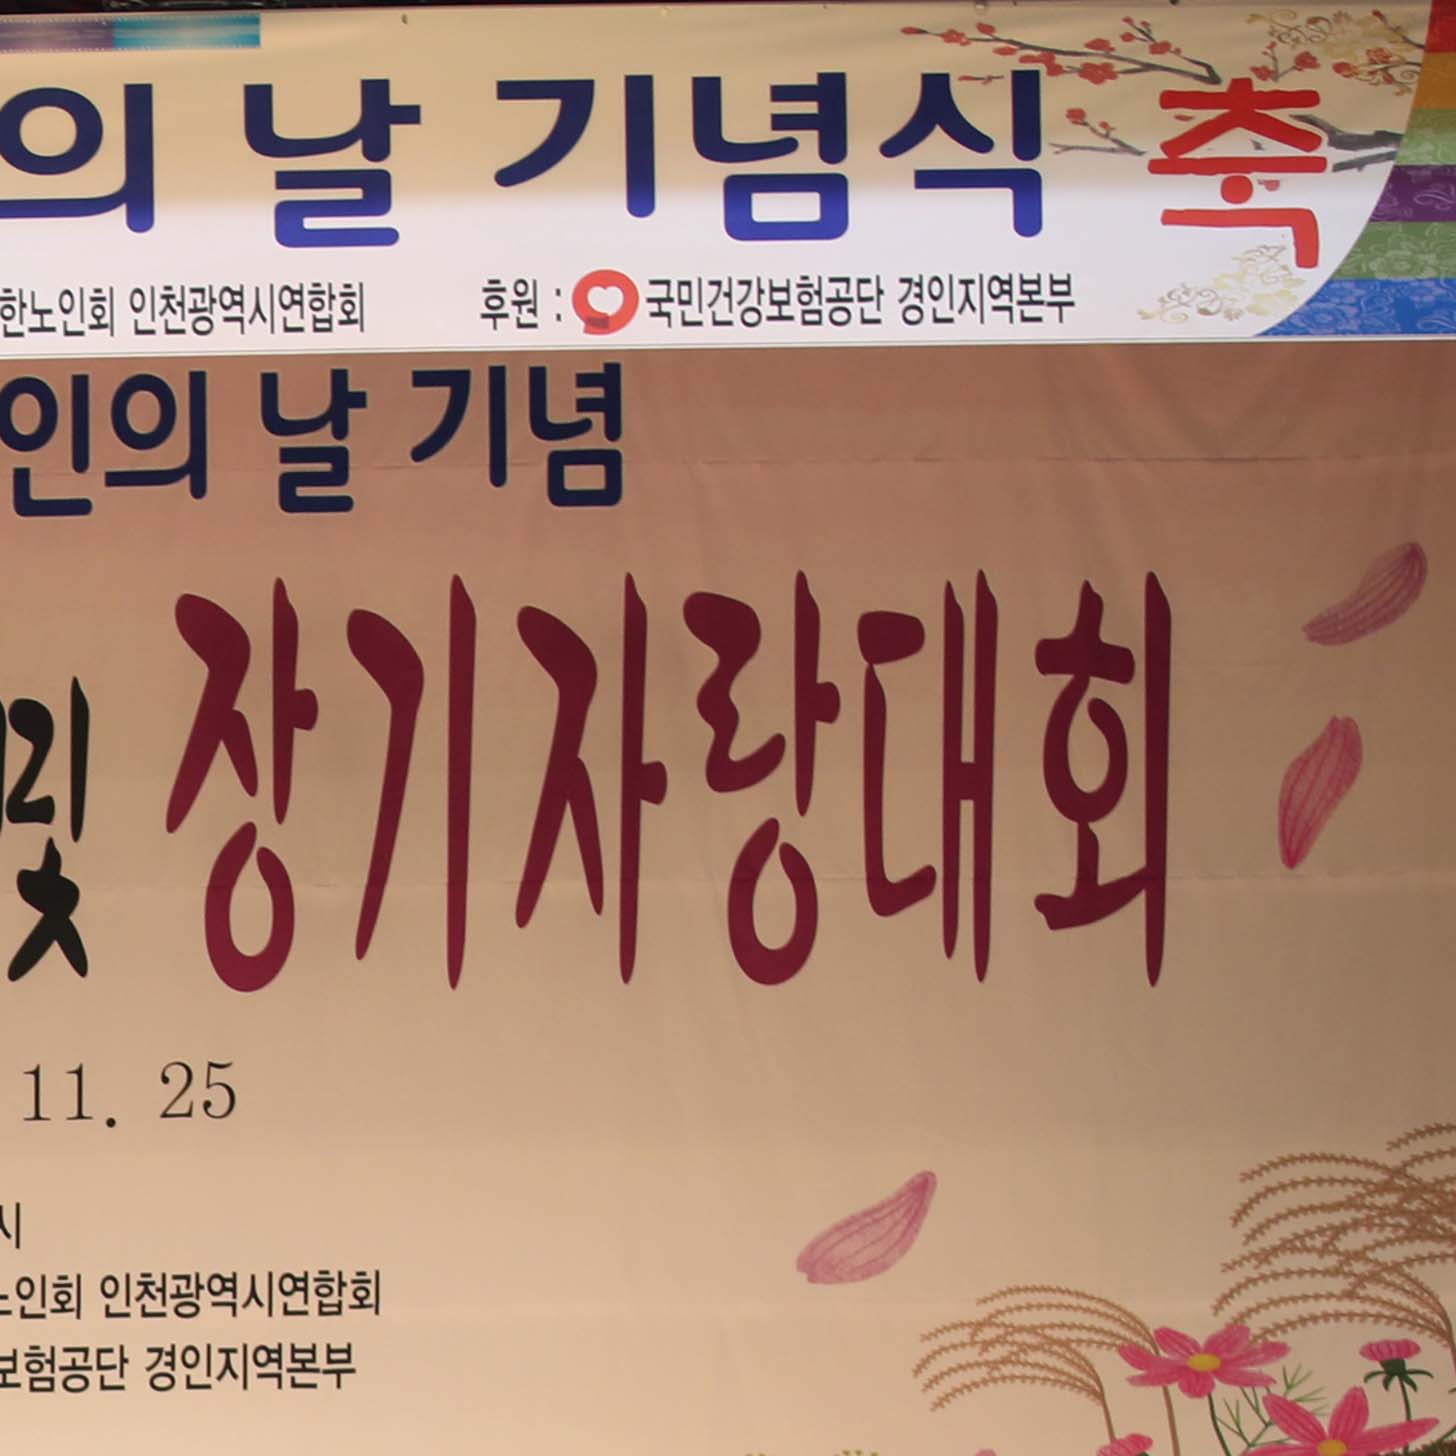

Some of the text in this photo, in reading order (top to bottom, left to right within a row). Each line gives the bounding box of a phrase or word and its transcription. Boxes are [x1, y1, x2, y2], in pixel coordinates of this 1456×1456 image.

[243, 78, 422, 249] 날
[493, 70, 1044, 242] 기념식
[1149, 79, 1330, 269] 축
[129, 282, 364, 336] 인천광역시연합회
[480, 278, 539, 331] 후원
[646, 274, 885, 328] 국민건강보험공단
[898, 273, 1076, 326] 경인지역본부
[260, 368, 367, 514] 날
[410, 362, 623, 508] 기념
[165, 568, 1173, 993] 장기자랑대회
[23, 1063, 116, 1129] 11.
[159, 1061, 236, 1119] 25
[100, 1269, 380, 1319] 인천광역시연합회
[145, 1342, 356, 1392] 경인지역본부
